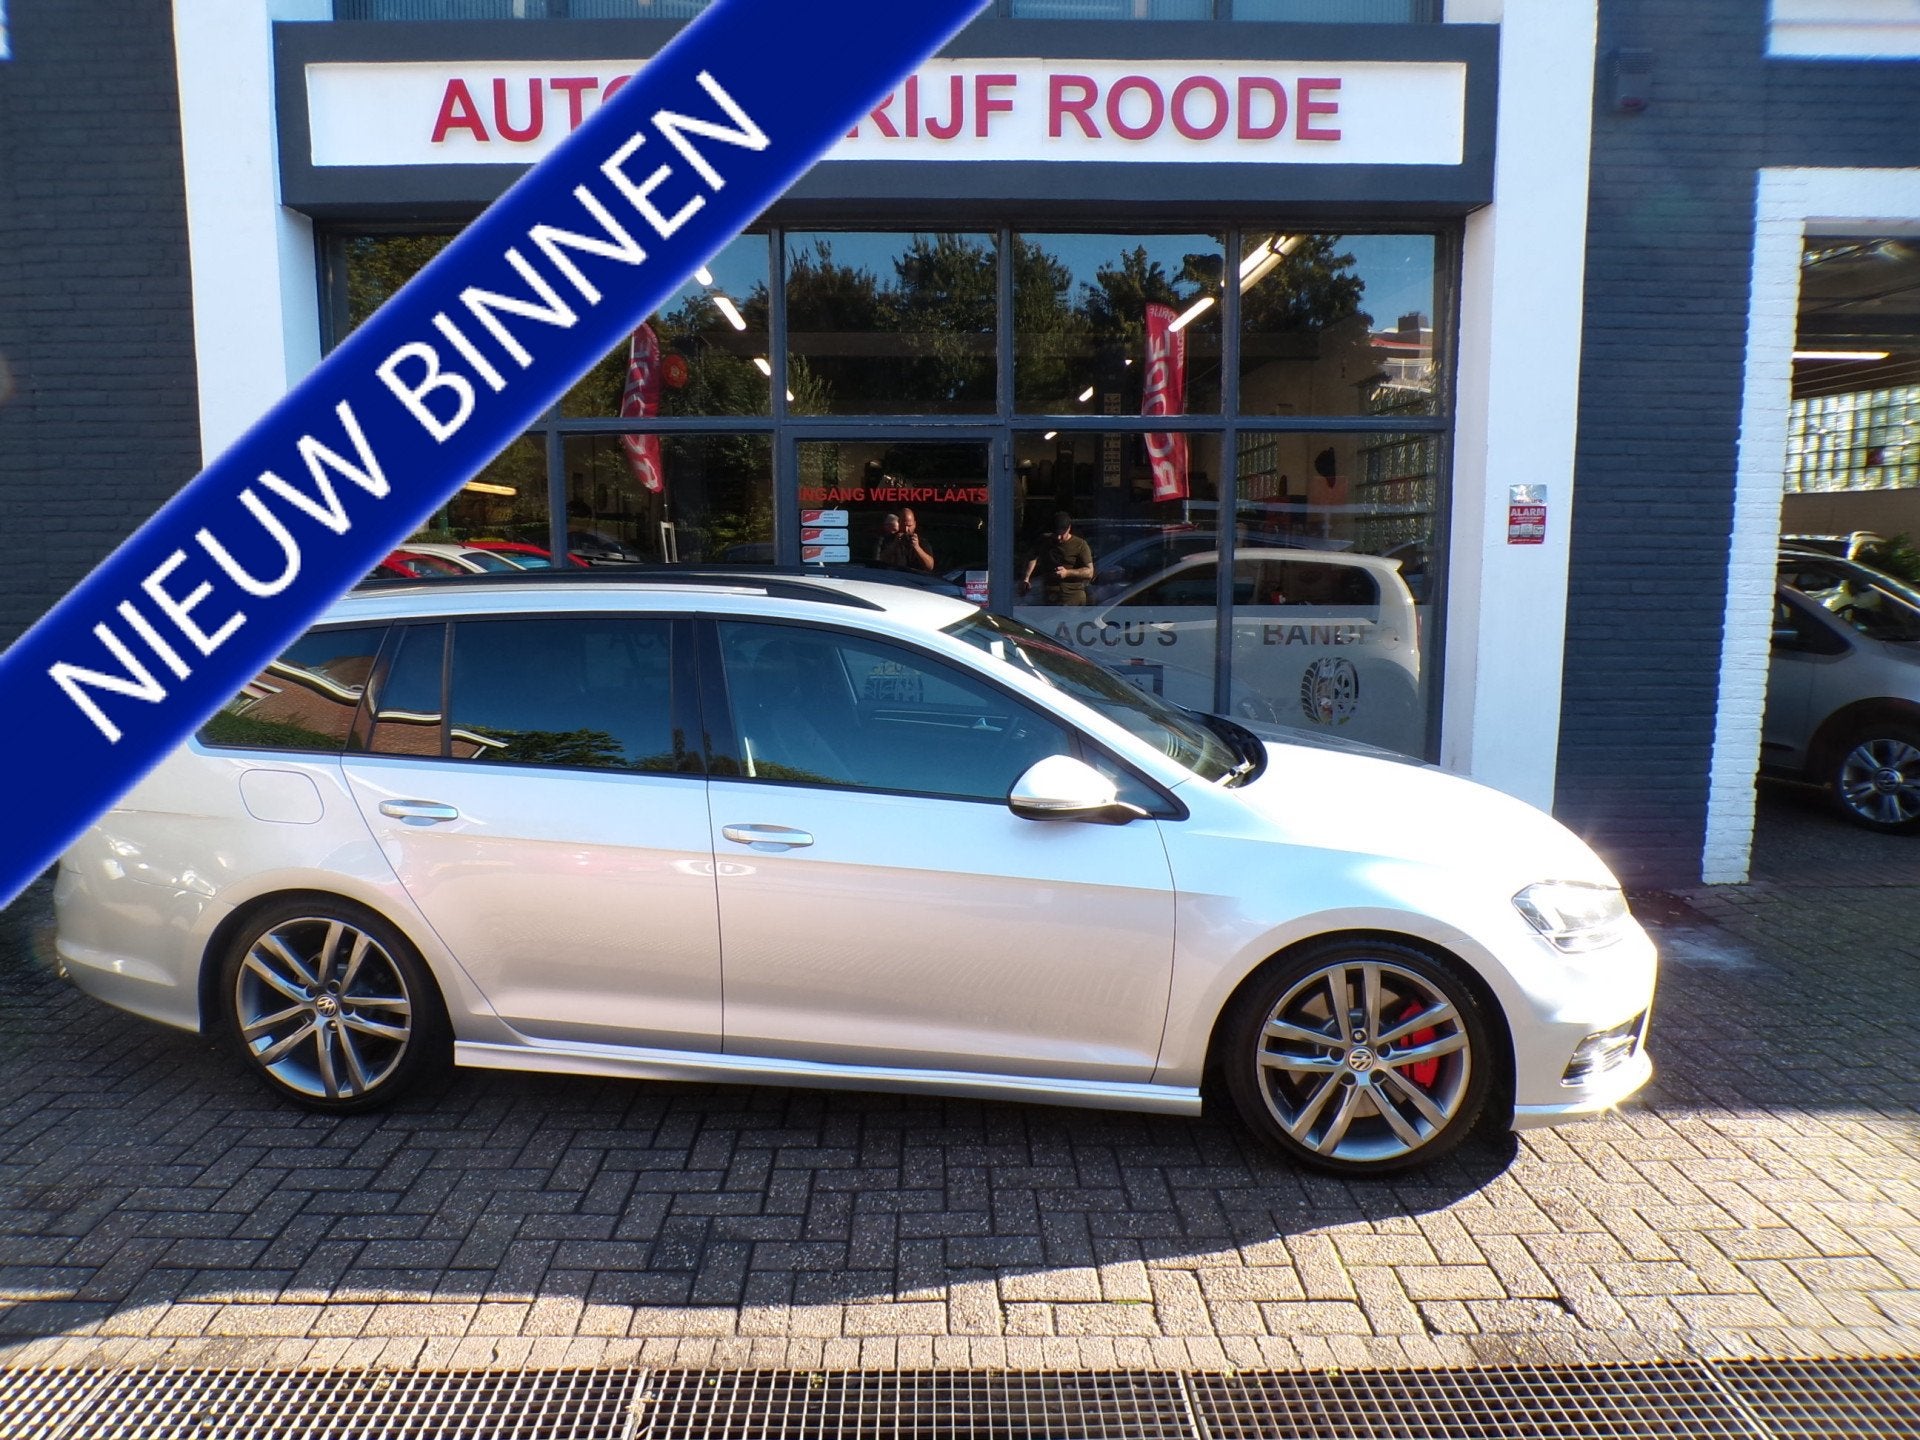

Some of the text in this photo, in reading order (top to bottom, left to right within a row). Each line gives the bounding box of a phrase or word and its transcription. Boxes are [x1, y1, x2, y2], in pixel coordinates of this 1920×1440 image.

[431, 74, 1343, 142] AUTIJF ROODE
[799, 487, 988, 501] INGANG WERKPLAATS
[1510, 508, 1545, 516] ALARM
[1055, 621, 1177, 647] ACCU'S
